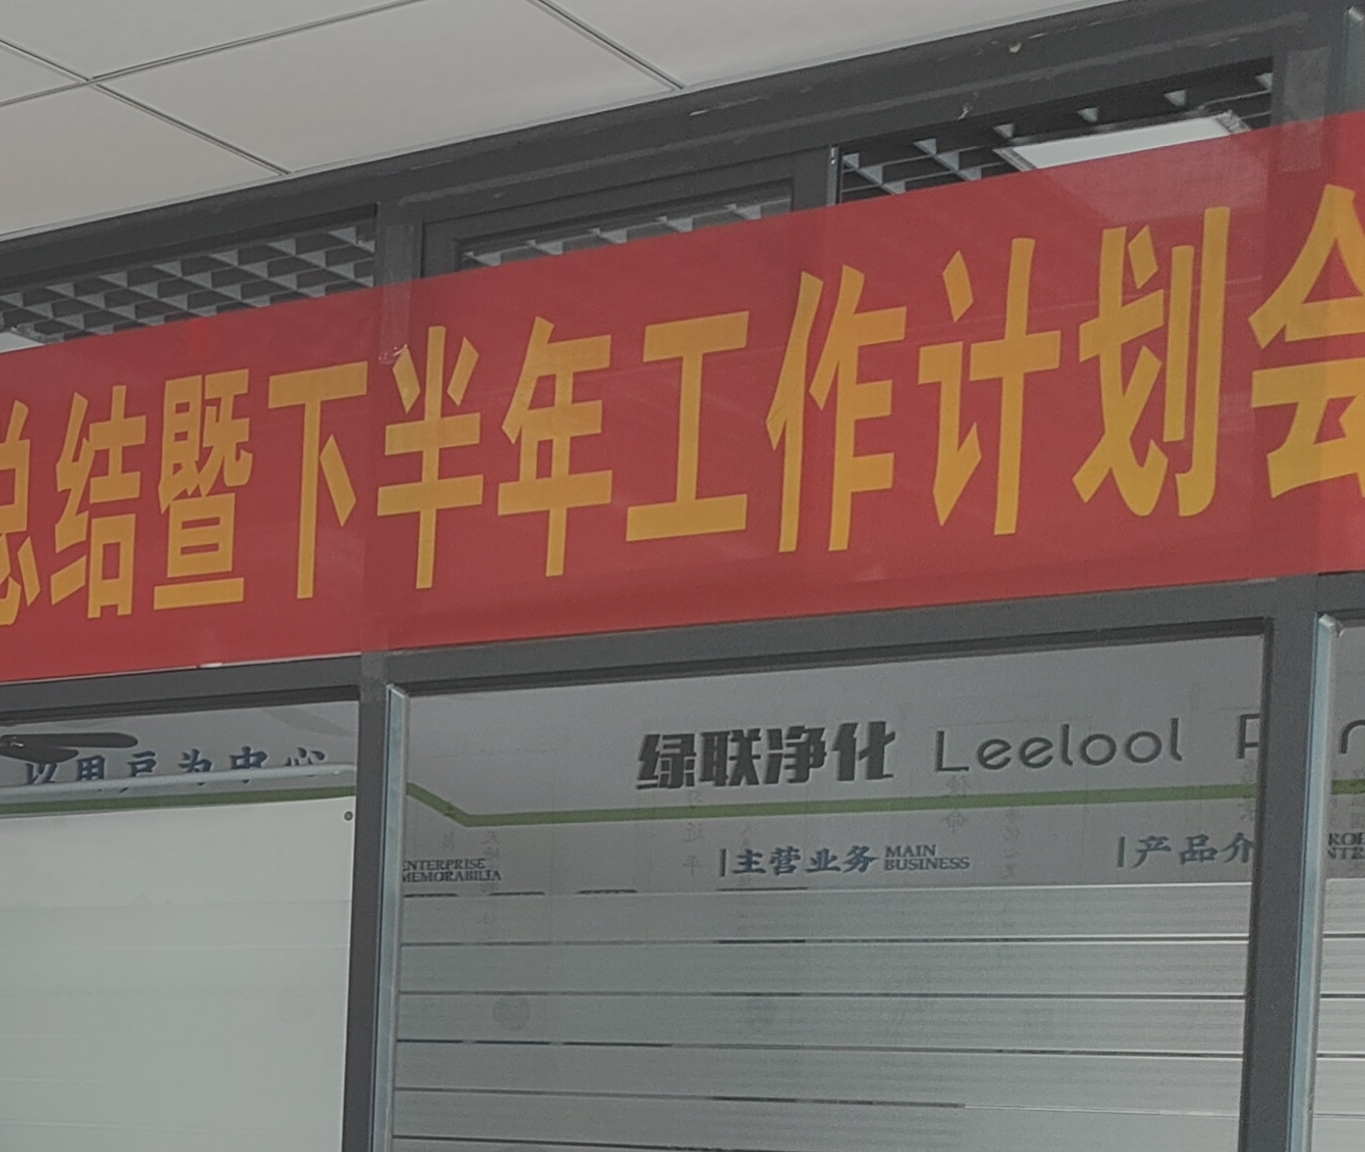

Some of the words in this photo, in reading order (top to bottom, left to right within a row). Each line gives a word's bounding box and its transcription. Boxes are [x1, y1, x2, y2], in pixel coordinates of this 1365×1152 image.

[636, 721, 896, 790] 绿联净化
[936, 716, 1183, 772] Leelool
[733, 846, 876, 876] 主营业务
[884, 844, 937, 858] MAIN
[884, 856, 970, 871] BUSINESS
